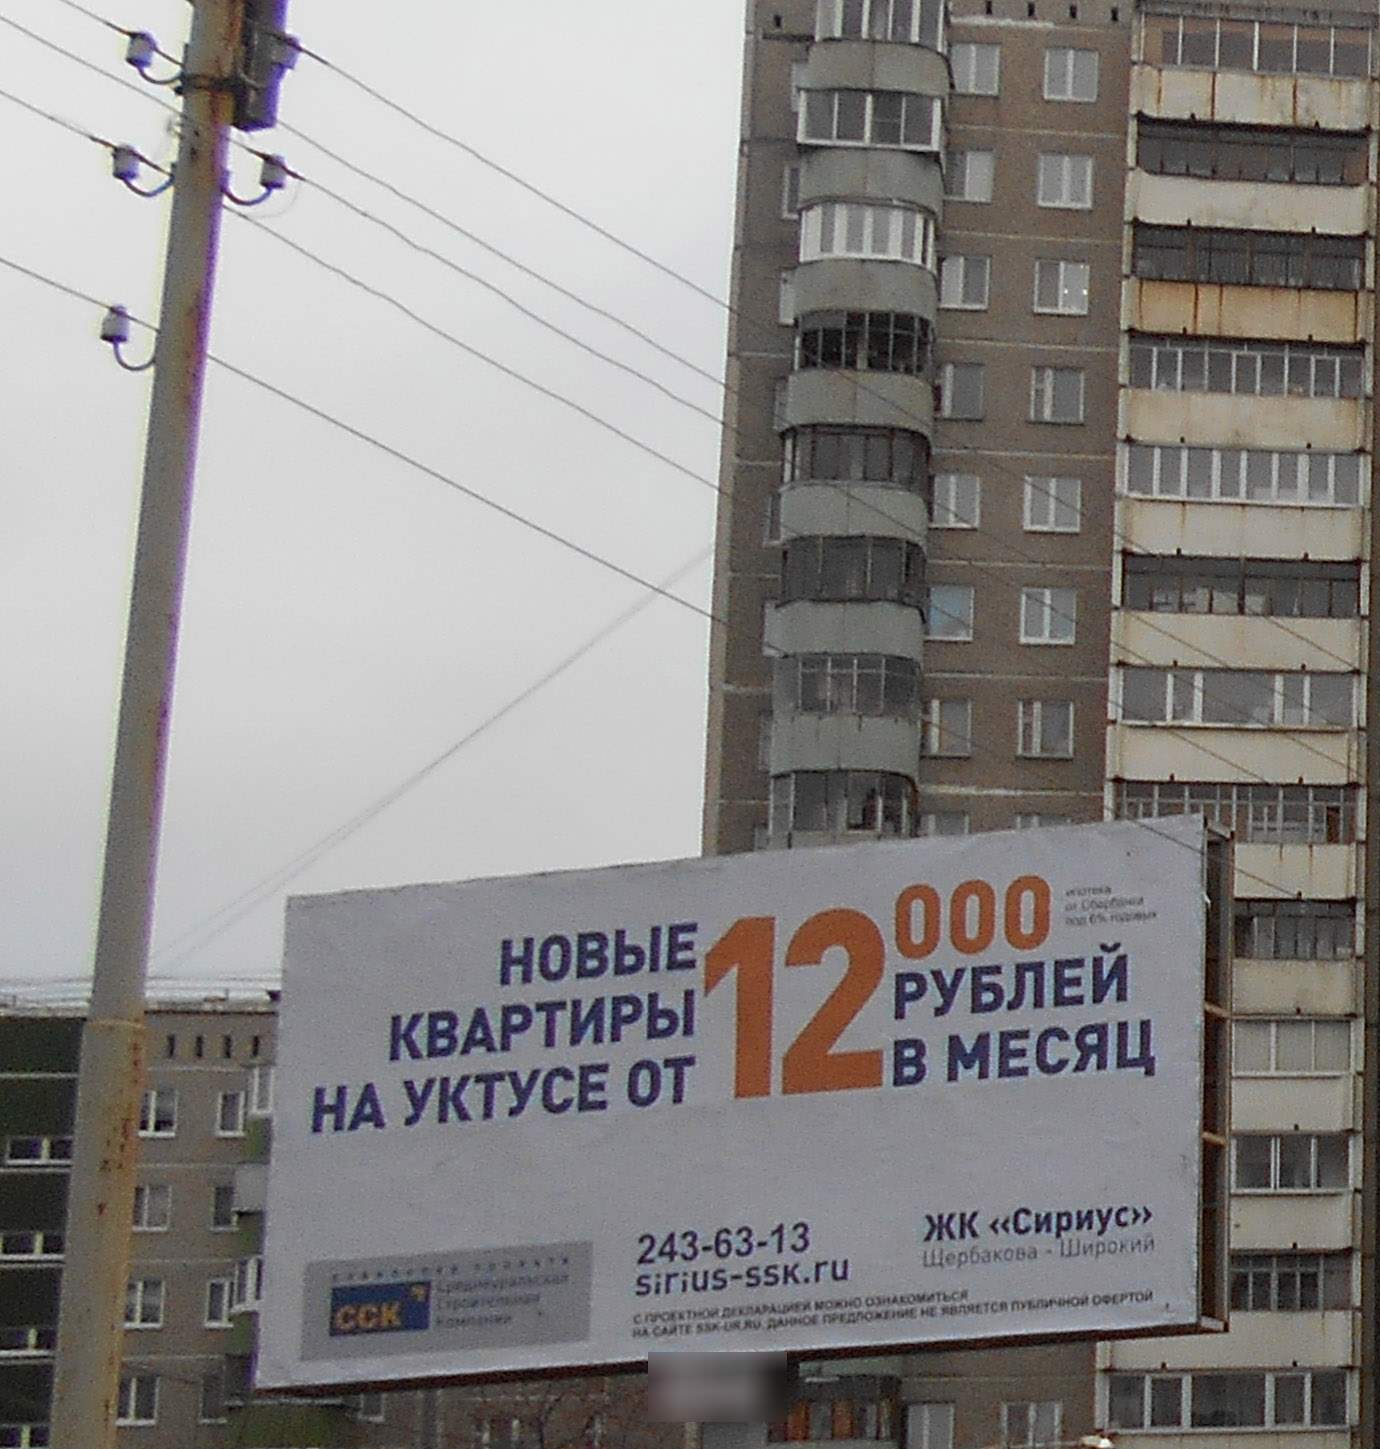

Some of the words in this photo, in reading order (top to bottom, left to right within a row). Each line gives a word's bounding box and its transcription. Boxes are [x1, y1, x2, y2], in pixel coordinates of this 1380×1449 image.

[500, 922, 698, 985] НОВЫЕ
[894, 942, 1128, 1020] РУБЛЕЙ
[704, 907, 886, 1098] 12
[895, 875, 1051, 959] 000
[389, 989, 695, 1061] КВАРТИРЫ
[893, 1038, 927, 1087] В
[947, 1019, 1156, 1082] МЕСЯЦ
[311, 1082, 385, 1133] НА
[403, 1062, 610, 1126] УКТУСЕ
[627, 1055, 696, 1107] ОТ
[637, 1221, 810, 1265] 243-63-13
[922, 1245, 1038, 1269] Щербакова
[1060, 1234, 1155, 1260] Широкий
[923, 1210, 979, 1242] ЖК
[989, 1206, 1153, 1238] «Сириус»
[635, 1258, 849, 1297] sirius-ssk.ru
[632, 1327, 648, 1338] НА
[652, 1322, 691, 1337] САЙТЕ
[767, 1314, 818, 1330] ДАННОЕ
[822, 1305, 917, 1325] ПРЕДЛОЖЕНИЕ
[921, 1305, 936, 1318] НЕ
[941, 1300, 1008, 1317] ЯВЛЯЕТСЯ
[1011, 1295, 1088, 1312] ПУБЛИЧНОЙ
[1092, 1290, 1153, 1307] ОФЕРТОЙ
[633, 1314, 642, 1325] С
[645, 1308, 719, 1322] ПРОЕКТНОЙ
[722, 1302, 811, 1318] ДЕКЛАРАЦИЕЙ
[814, 1297, 861, 1311] МОЖНО
[865, 1289, 968, 1307] ОЗНАКОМИТЬСЯ
